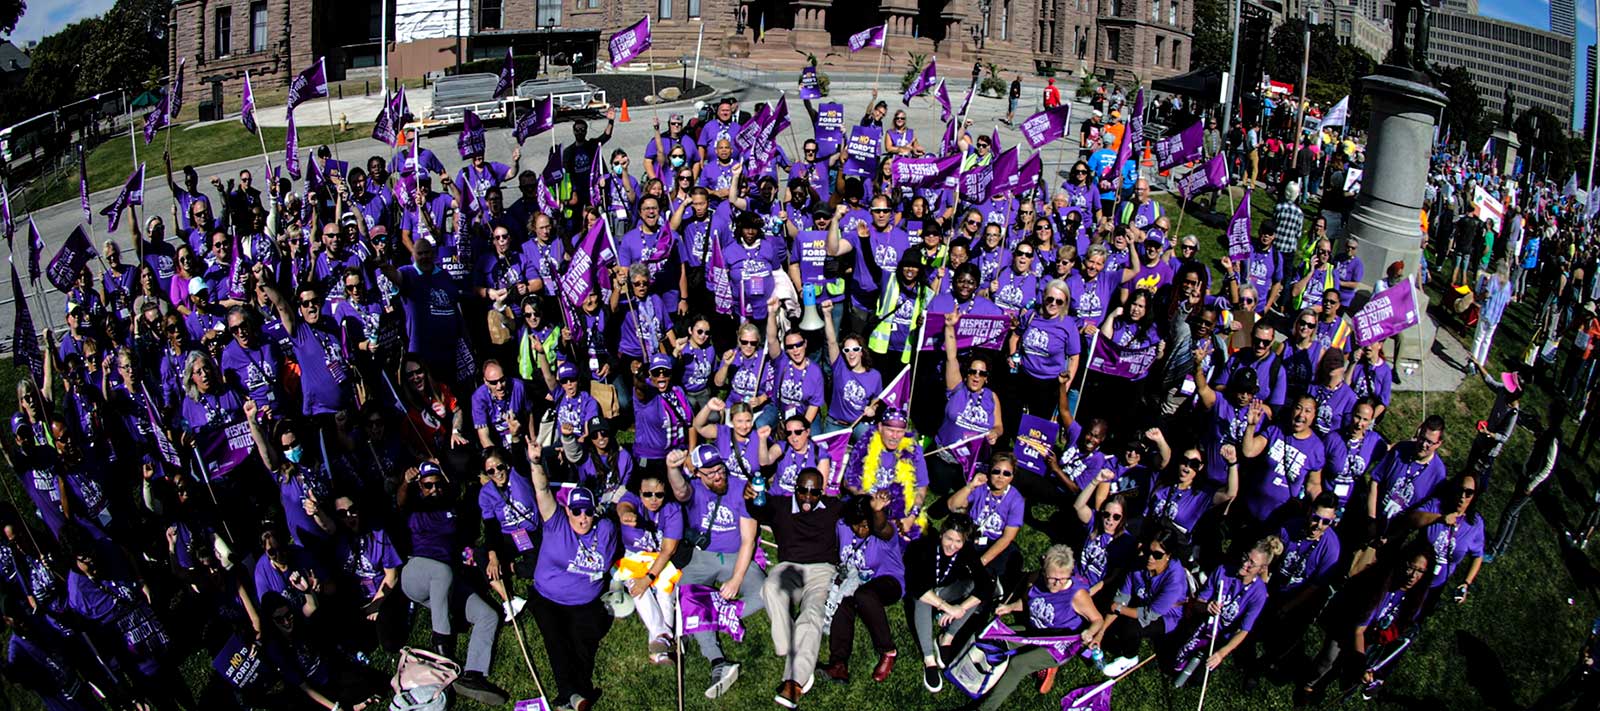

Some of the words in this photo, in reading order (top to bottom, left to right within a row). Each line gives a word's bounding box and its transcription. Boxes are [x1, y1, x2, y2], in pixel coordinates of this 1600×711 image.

[828, 110, 836, 118] NO
[858, 136, 870, 144] NO
[849, 142, 875, 152] FORD'S
[814, 240, 824, 248] NO
[960, 318, 992, 328] RESPECT
[957, 327, 990, 336] PROTECT
[224, 420, 251, 438] RESPEC
[1030, 428, 1042, 438] NO
[228, 433, 254, 450] PROTEC
[240, 647, 248, 656] TO
[230, 653, 242, 669] NO
[226, 666, 235, 678] SAY
[232, 656, 254, 684] FORD'S
